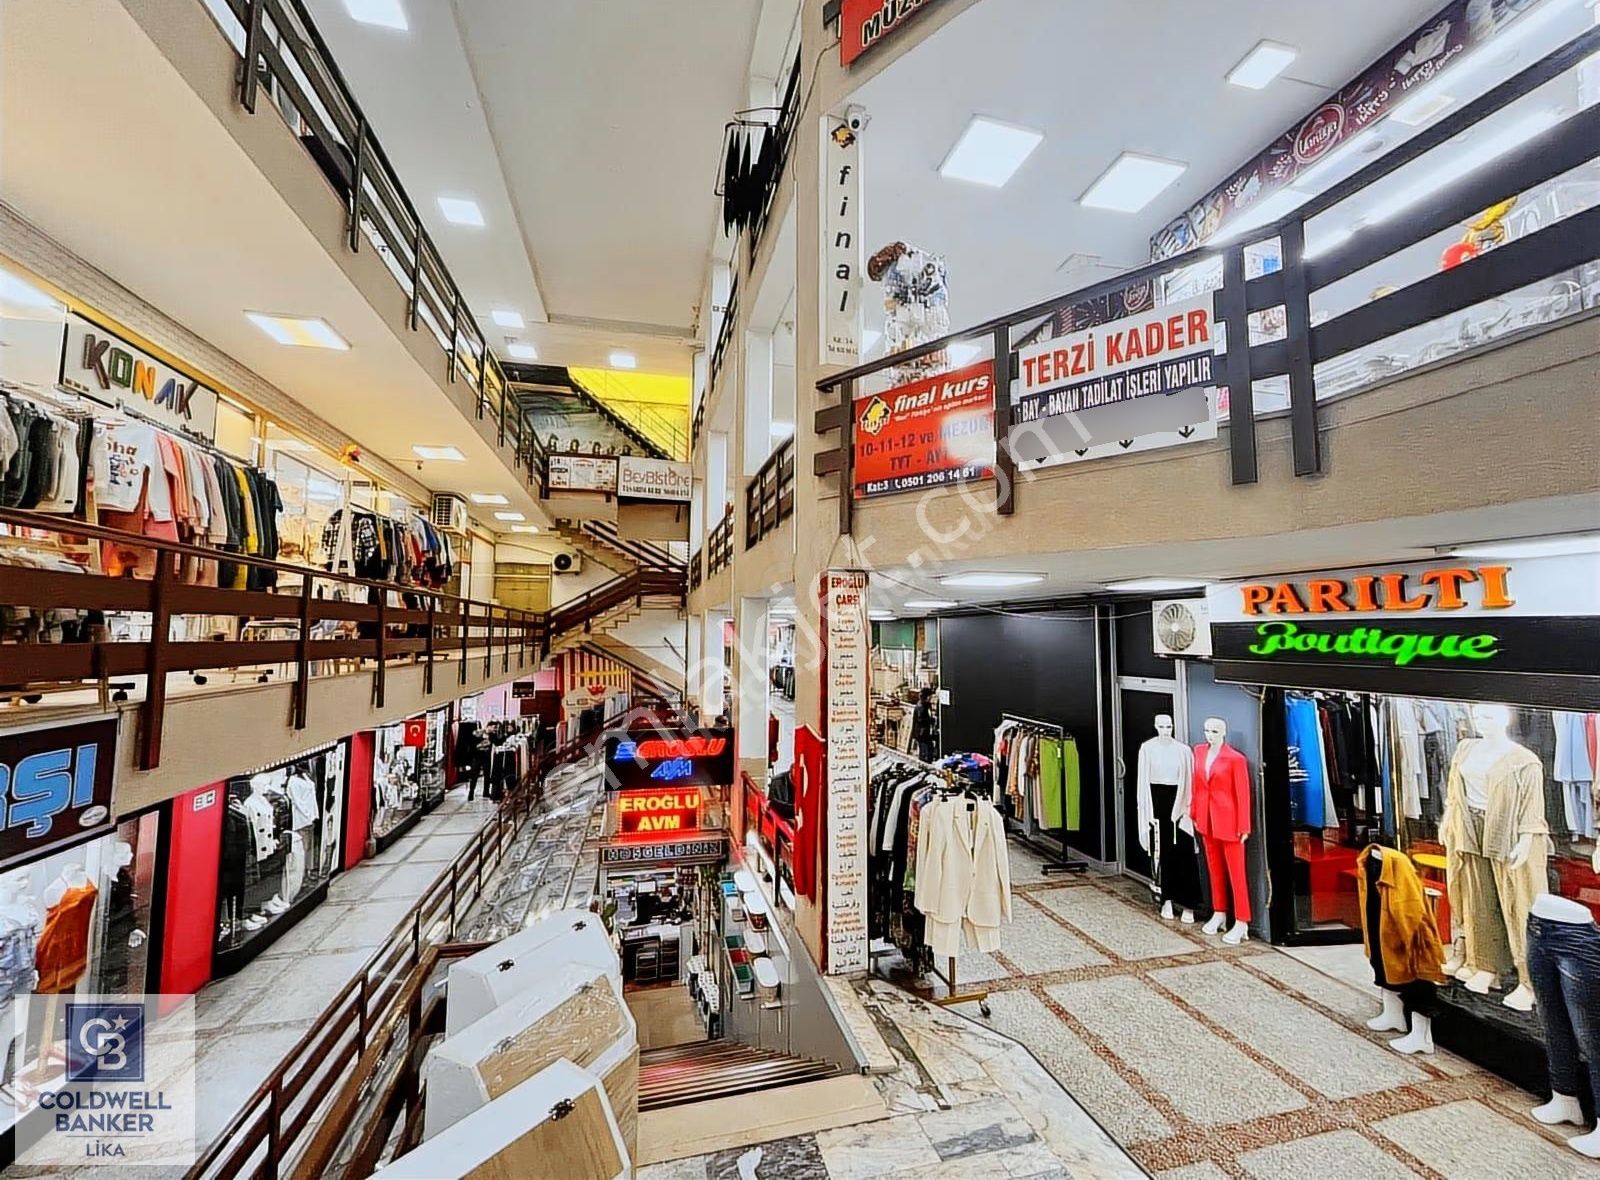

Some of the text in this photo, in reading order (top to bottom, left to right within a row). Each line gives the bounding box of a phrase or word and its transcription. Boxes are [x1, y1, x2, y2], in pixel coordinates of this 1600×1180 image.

[1023, 309, 1209, 387] TERZİ KADER
[83, 334, 198, 420] KONAK
[894, 375, 989, 413] final kurs
[1022, 398, 1040, 422] BAY
[1049, 387, 1080, 415] BAYAN
[1082, 377, 1124, 407] TADİLAT
[1126, 364, 1162, 399] İŞLERİ
[1165, 357, 1211, 389] YAPILIR
[860, 433, 915, 457] 10-11-12
[1241, 565, 1514, 615] PARILTI
[1249, 621, 1499, 666] Boutique
[637, 815, 681, 831] AVM
